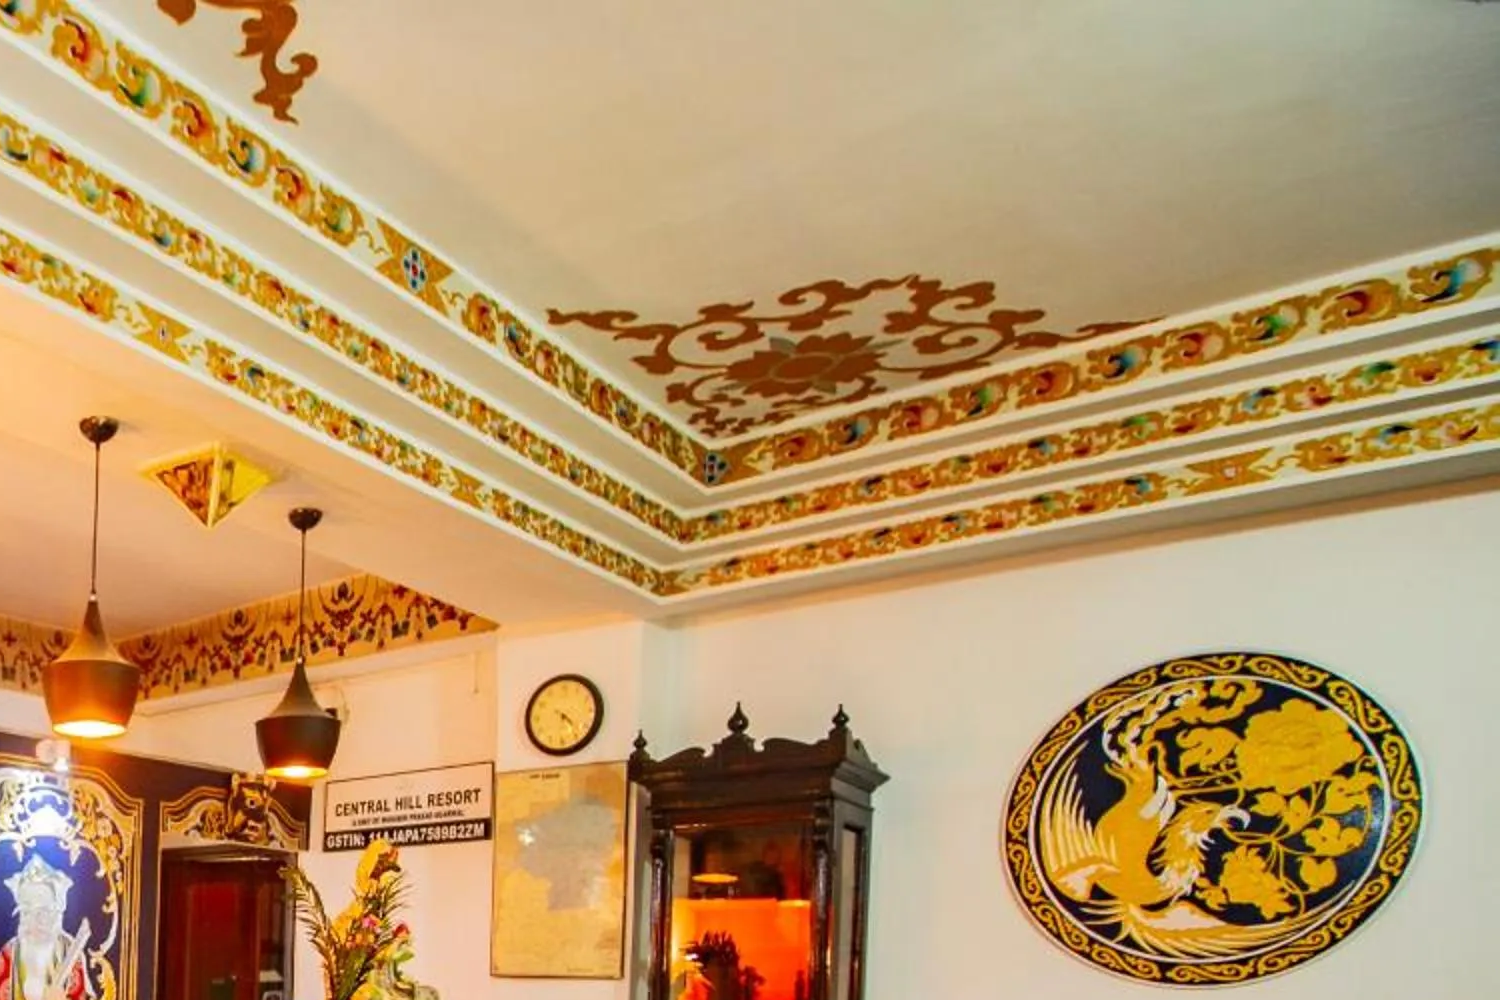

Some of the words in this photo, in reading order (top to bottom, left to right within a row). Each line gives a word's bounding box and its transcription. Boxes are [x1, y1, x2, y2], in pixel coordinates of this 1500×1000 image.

[335, 799, 390, 817] CENTRAL
[395, 796, 422, 810] HILL
[427, 788, 481, 807] RESORT
[327, 833, 365, 848] GSTIN:
